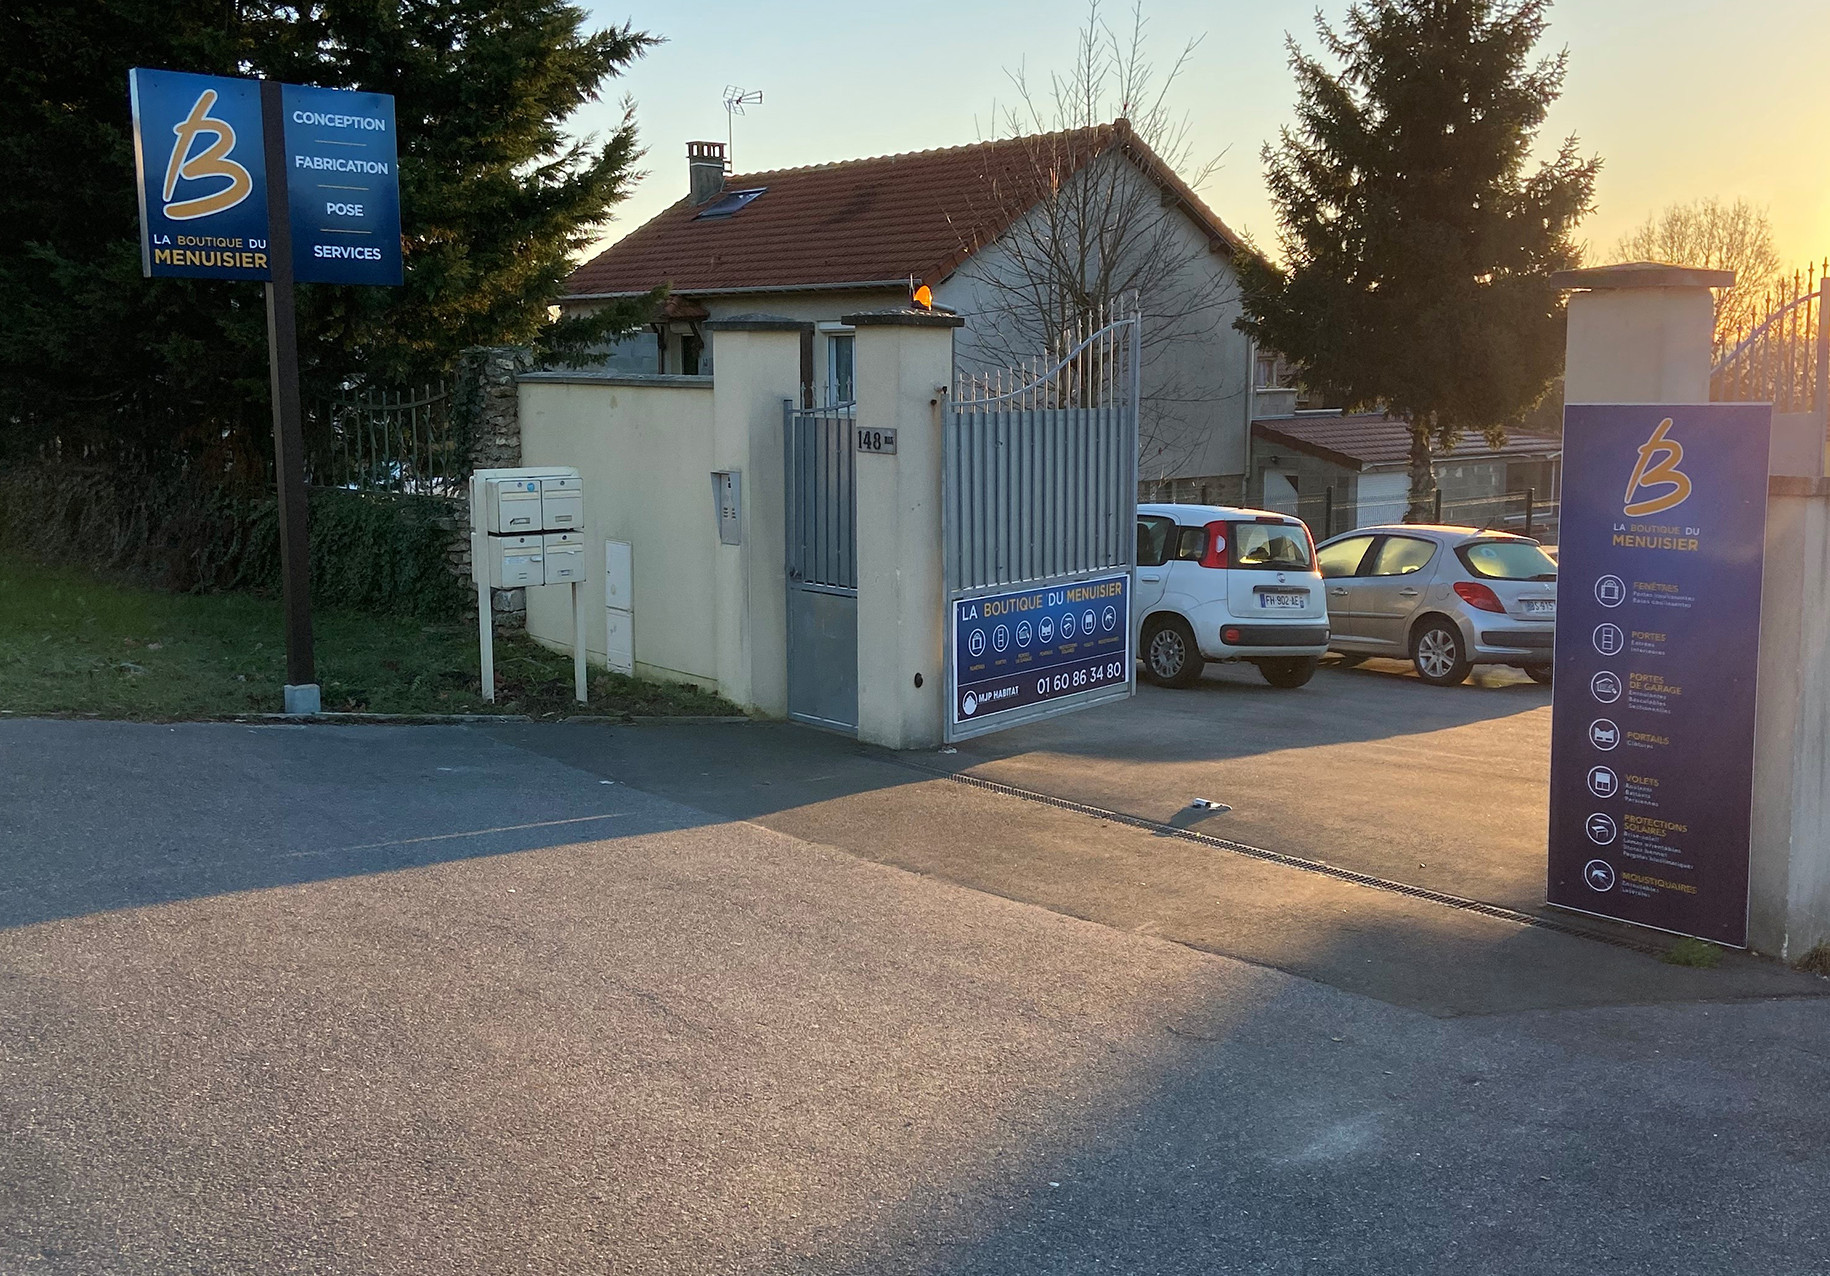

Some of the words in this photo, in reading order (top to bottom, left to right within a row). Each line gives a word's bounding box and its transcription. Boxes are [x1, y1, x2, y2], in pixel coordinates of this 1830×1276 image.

[293, 110, 386, 131] CONCEPTION
[295, 155, 389, 175] FABRICATION
[326, 202, 364, 216] POSE
[153, 234, 171, 245] LA
[177, 235, 243, 248] BOUTIQUE
[249, 238, 266, 249] DU
[154, 249, 268, 268] MENUISIER
[314, 245, 382, 260] SERVICES
[858, 430, 881, 450] 148
[1613, 523, 1626, 531] LA
[1630, 524, 1681, 535] BOUTIQUE
[1685, 527, 1700, 536] DU
[1612, 534, 1699, 552] MENUISIER
[961, 605, 978, 621] LA
[984, 594, 1043, 618] BOUTIQUE
[1048, 591, 1064, 606] DU
[1066, 581, 1123, 604] MENUISIER
[1631, 630, 1667, 642] PORTES
[1036, 677, 1050, 694] 01
[1053, 673, 1069, 690] 60
[1072, 669, 1087, 686] 86
[1090, 665, 1103, 682] 34
[1106, 661, 1122, 678] 80
[1630, 672, 1664, 685] PORTES
[993, 686, 1020, 699] HABITAT
[1630, 681, 1642, 690] DE
[1643, 682, 1682, 695] GARAGE
[1627, 731, 1670, 745] PORTAILS
[1624, 774, 1660, 787] VOLETS
[1624, 814, 1688, 833] PROTECTIONS
[1624, 822, 1667, 838] SOLAIRES
[1622, 872, 1697, 895] MOUSTIQUAIRES
